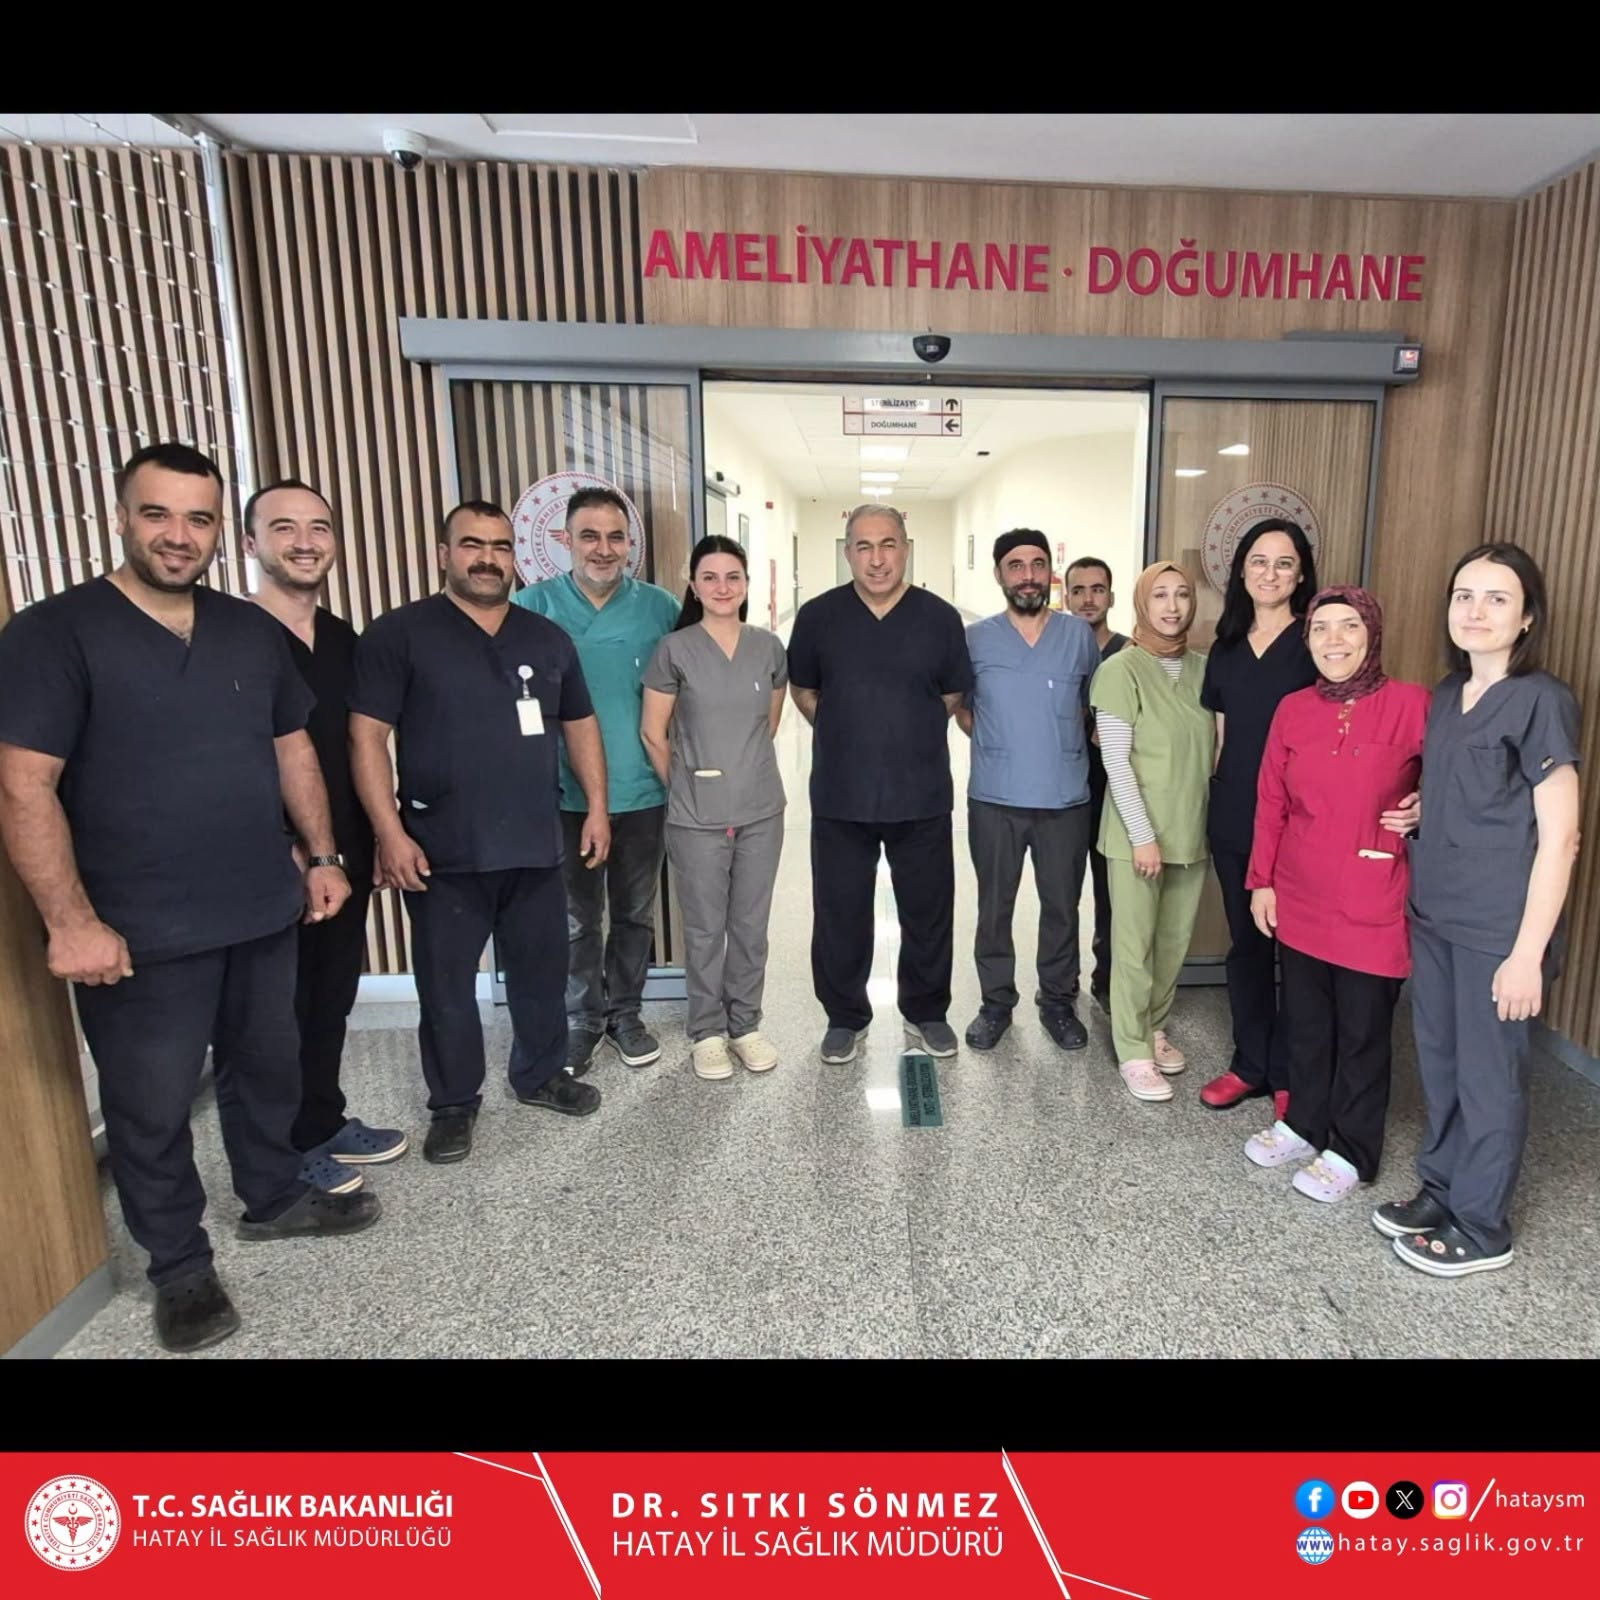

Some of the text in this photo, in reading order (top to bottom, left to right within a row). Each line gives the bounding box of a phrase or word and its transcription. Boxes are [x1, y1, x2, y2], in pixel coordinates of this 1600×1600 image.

[643, 224, 1049, 293] AMELİYATHANE
[1088, 239, 1426, 302] DOĞUMHANE
[871, 420, 917, 429] DOĞUMHANE
